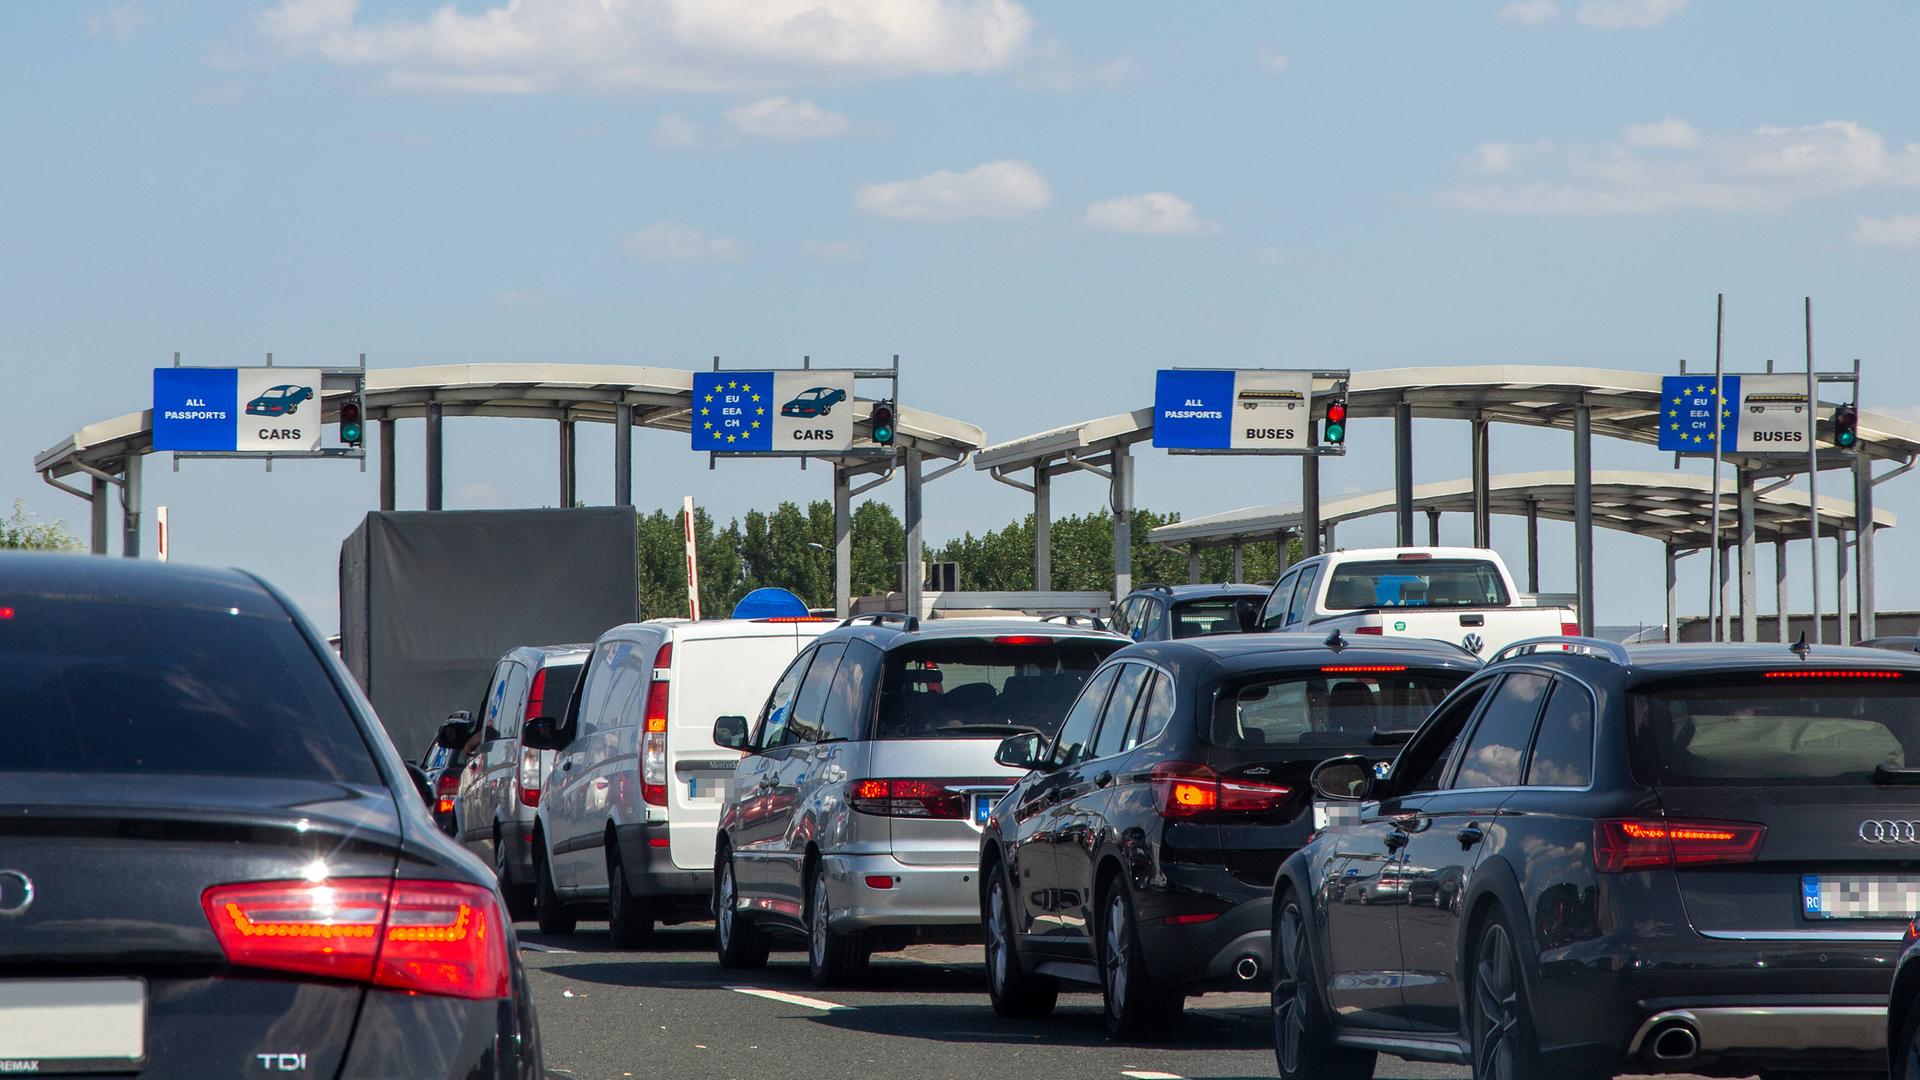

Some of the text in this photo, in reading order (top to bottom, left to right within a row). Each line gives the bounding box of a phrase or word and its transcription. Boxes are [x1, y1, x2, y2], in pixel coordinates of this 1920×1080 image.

[186, 399, 206, 407] ALL
[725, 395, 740, 403] EU
[1185, 399, 1204, 407] ALL
[1693, 398, 1708, 406] EU
[164, 411, 226, 420] PASSPORTS
[722, 407, 743, 416] EEA
[1165, 410, 1223, 419] PASSPORTS
[1690, 409, 1710, 418] EEA
[724, 419, 740, 428] CH
[1691, 421, 1707, 429] CH
[258, 428, 301, 440] CARS
[793, 429, 834, 441] CARS
[1246, 428, 1295, 440] BUSES
[1753, 431, 1802, 442] BUSES
[256, 1053, 306, 1070] TDI
